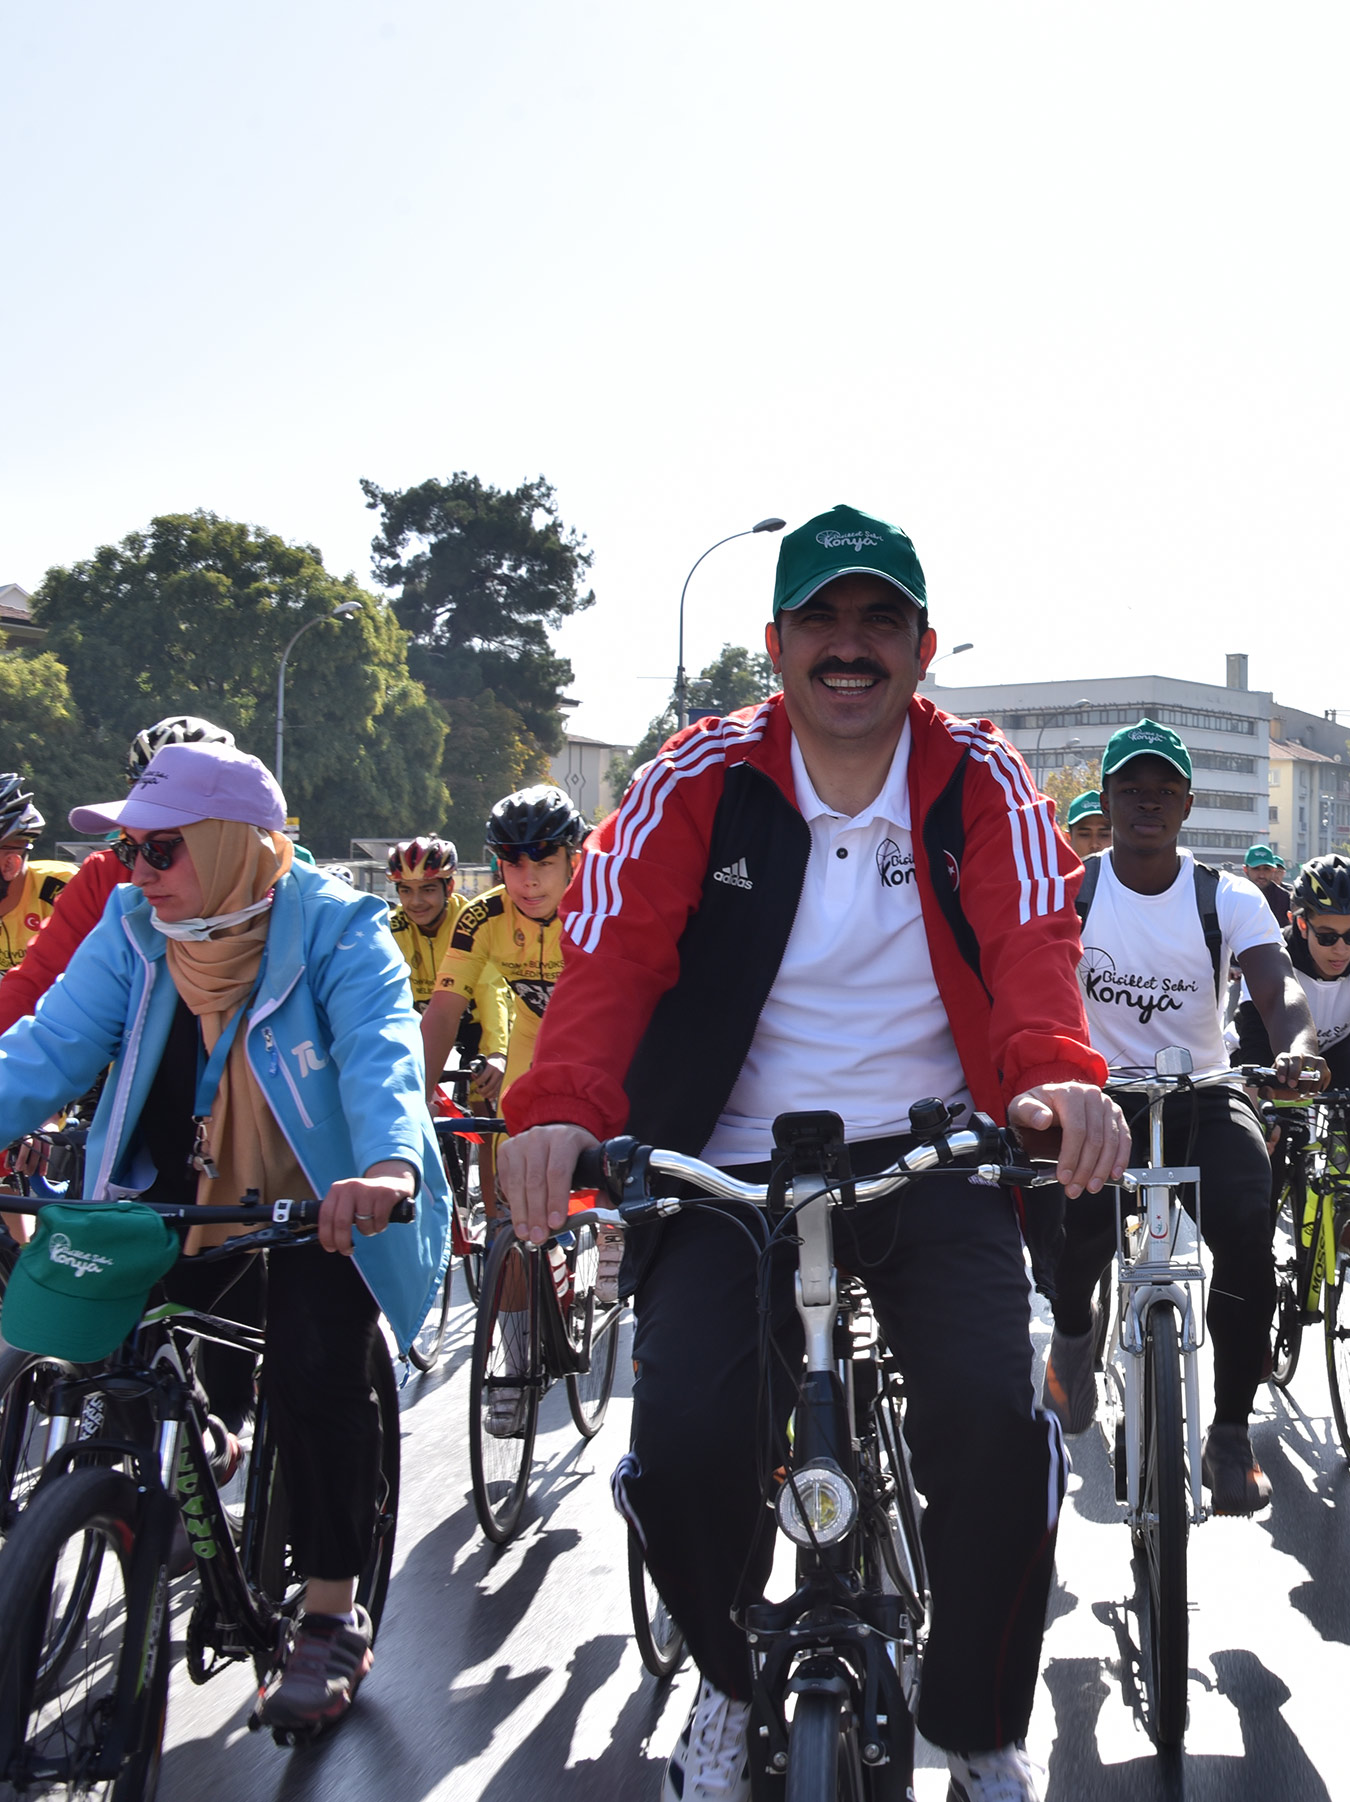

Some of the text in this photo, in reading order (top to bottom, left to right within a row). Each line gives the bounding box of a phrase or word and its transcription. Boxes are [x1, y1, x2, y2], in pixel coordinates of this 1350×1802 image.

[824, 536, 877, 552] Konya
[1131, 732, 1163, 744] Konya
[891, 853, 915, 867] Bisi
[881, 861, 916, 887] Kon
[1103, 970, 1199, 993] Bisiklet Şehri
[1086, 972, 1183, 1024] Konya
[50, 1244, 103, 1278] Konya
